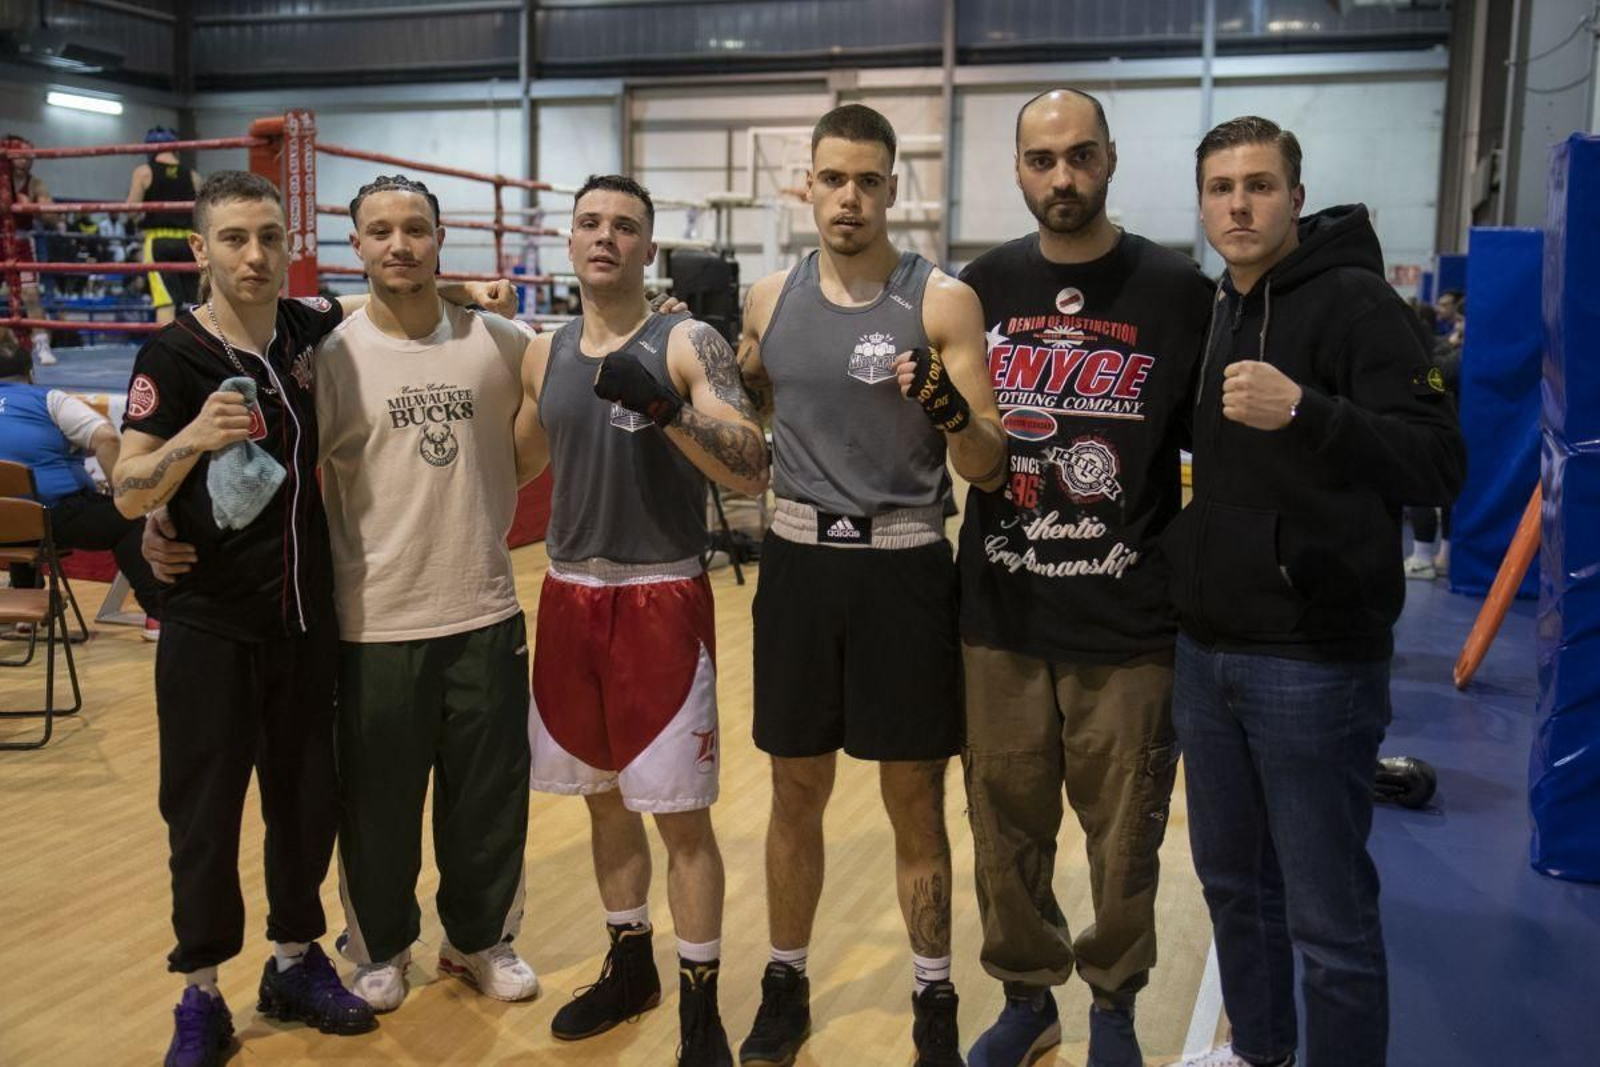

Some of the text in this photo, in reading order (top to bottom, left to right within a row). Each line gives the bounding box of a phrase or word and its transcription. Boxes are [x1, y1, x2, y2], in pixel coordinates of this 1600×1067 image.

[1007, 315, 1046, 335] DENIM
[1048, 315, 1061, 327] OF
[1062, 316, 1138, 347] DISTINCTION
[988, 344, 1155, 399] ENYCE
[387, 389, 473, 409] MILWAUKEE
[995, 391, 1145, 414] OTHING COMPANY
[388, 401, 474, 429] BUCKS
[1010, 455, 1041, 475] SINCE
[1070, 454, 1108, 485] ENYCE
[827, 529, 861, 538] adidas
